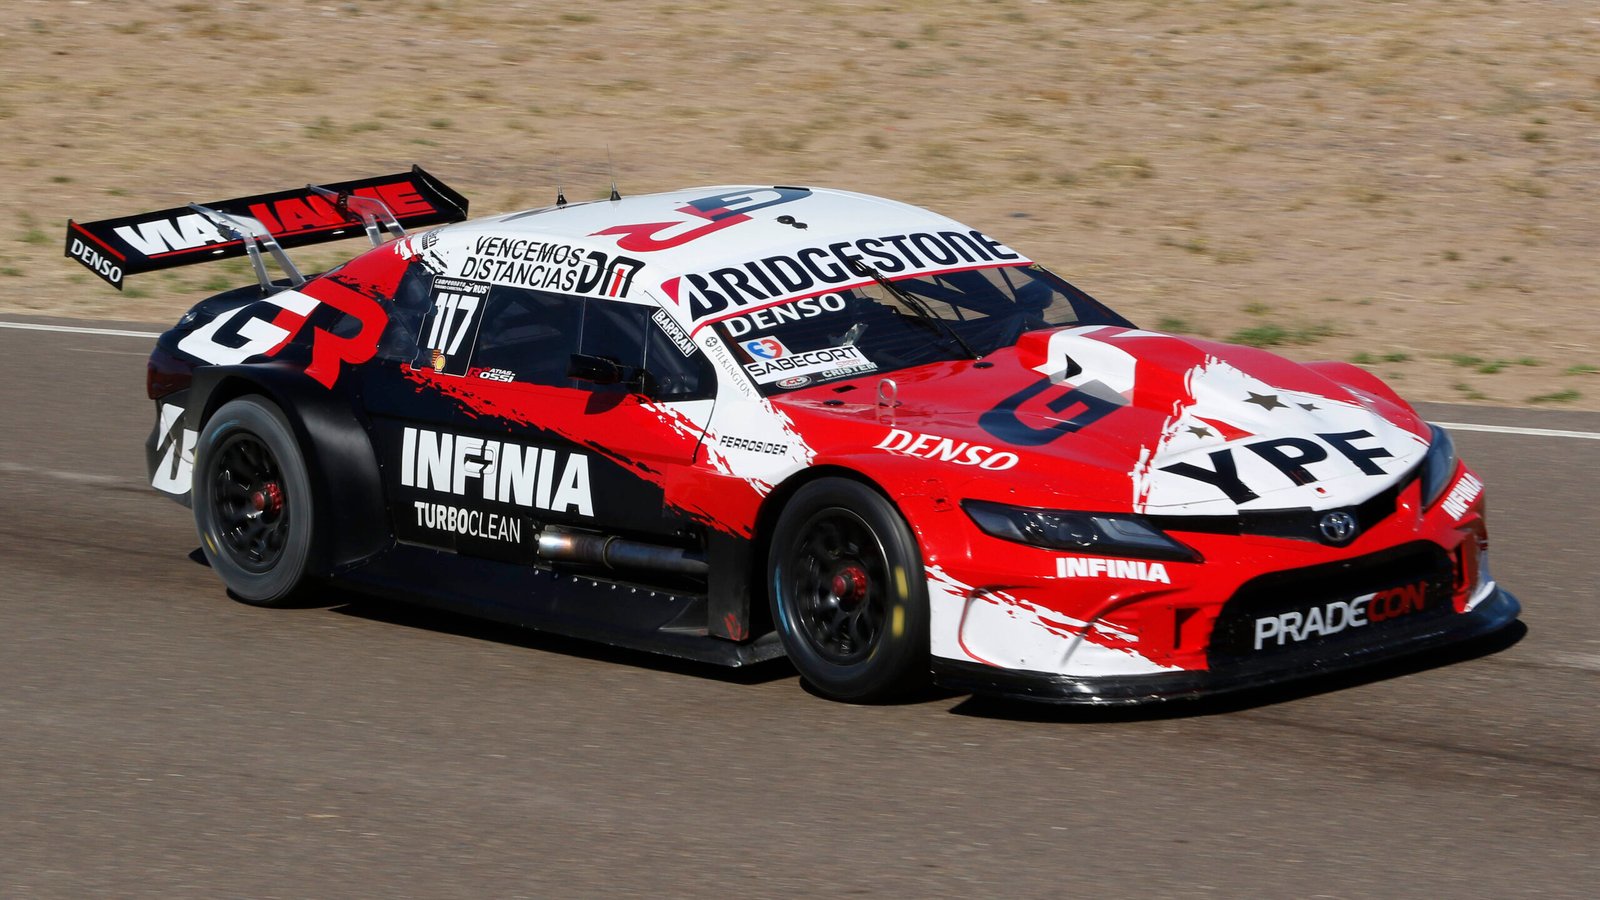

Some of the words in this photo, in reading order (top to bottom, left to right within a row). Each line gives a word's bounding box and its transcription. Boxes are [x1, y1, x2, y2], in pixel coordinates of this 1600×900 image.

[71, 238, 122, 282] DENSO
[476, 236, 585, 267] VENCEMOS
[460, 257, 577, 292] DISTANCIAS
[687, 231, 1018, 322] BRIDGESTONE
[427, 292, 480, 355] 117
[654, 310, 695, 354] BARPRAN
[721, 293, 846, 337] DENSO
[467, 367, 516, 383] ROSSI
[714, 346, 752, 397] PILKINGTON
[748, 347, 857, 377] SABECORT
[719, 435, 788, 456] FERROSIDER
[873, 428, 1020, 471] DENSO
[1159, 429, 1393, 504] YPF
[402, 427, 593, 517] INFINIA
[1056, 556, 1171, 584] INFINIA
